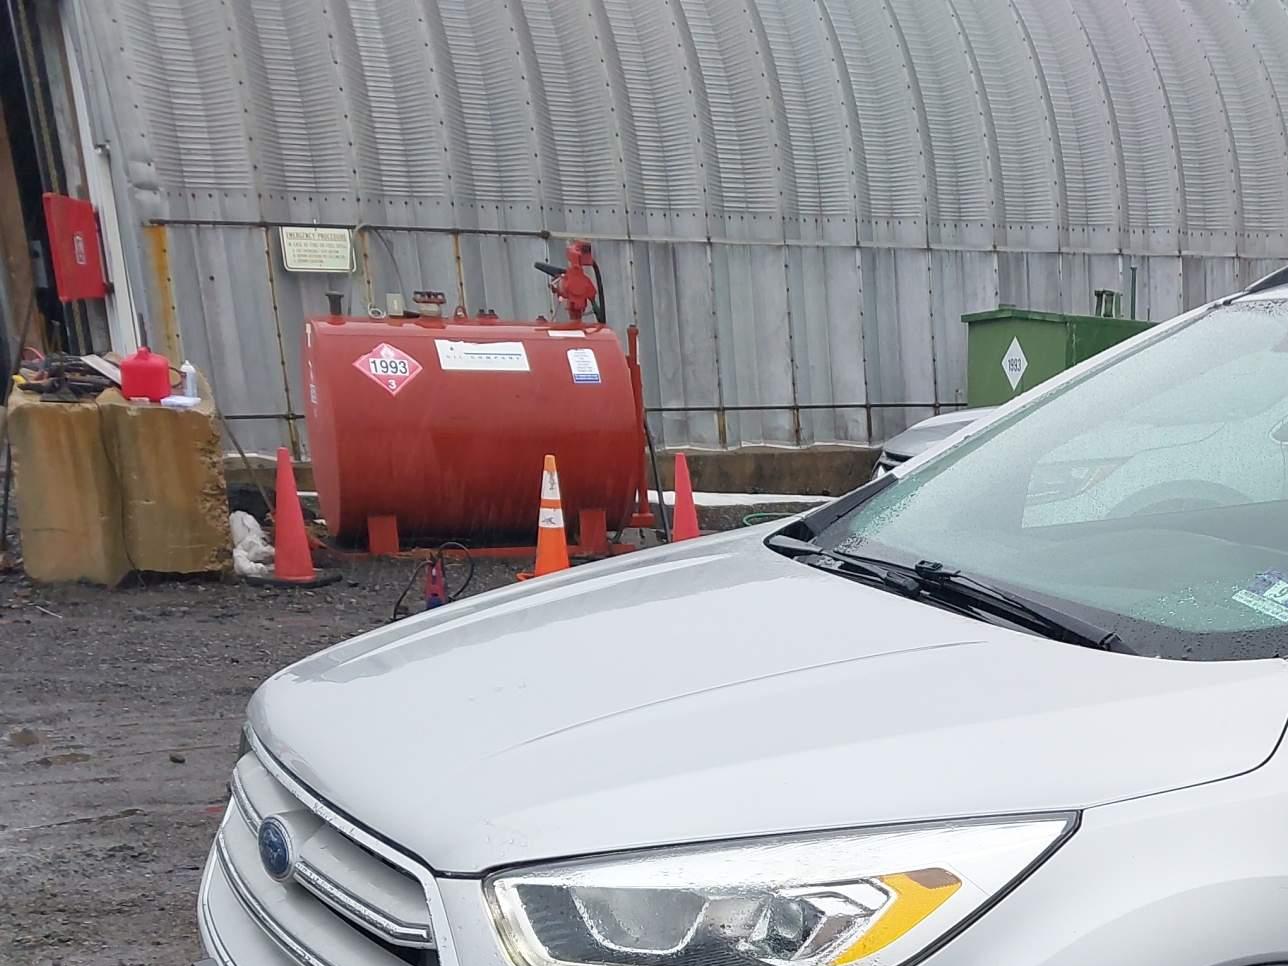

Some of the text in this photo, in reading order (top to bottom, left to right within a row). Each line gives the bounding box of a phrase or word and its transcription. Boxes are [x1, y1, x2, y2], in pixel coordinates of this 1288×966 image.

[371, 359, 408, 375] 1993
[1007, 358, 1022, 372] 1993
[388, 379, 397, 390] 3
